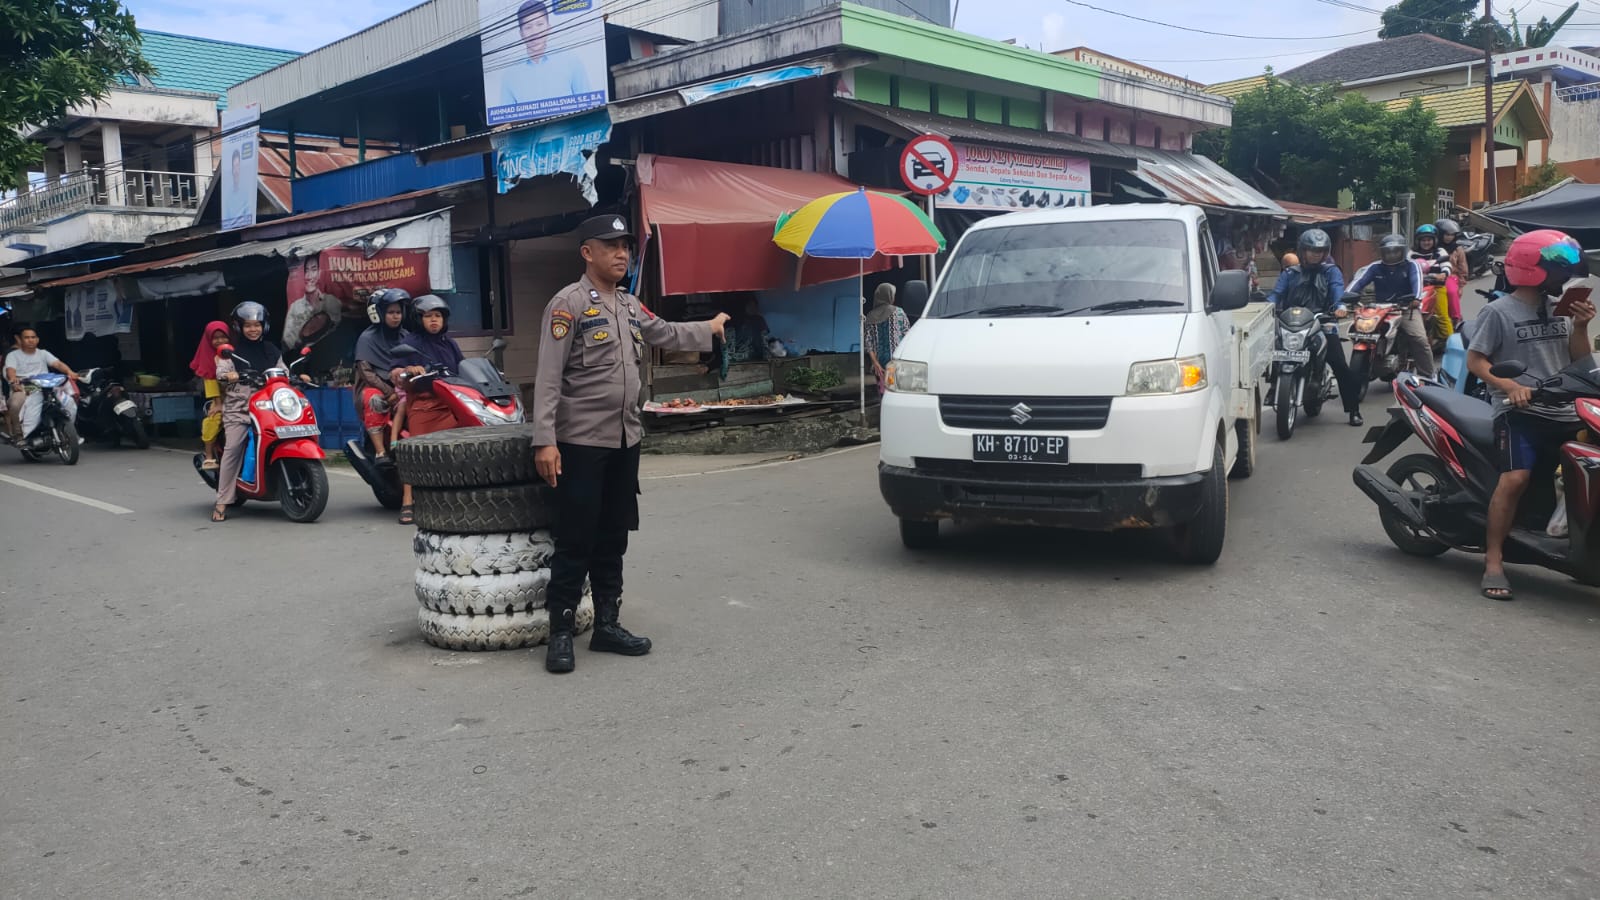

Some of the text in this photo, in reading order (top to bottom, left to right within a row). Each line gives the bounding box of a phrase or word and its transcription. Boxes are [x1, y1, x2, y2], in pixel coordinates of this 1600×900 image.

[490, 106, 515, 116] AKHMAD
[362, 256, 404, 271] PEDASNYA
[379, 266, 416, 281] SUASANA
[1516, 322, 1568, 339] GUESS
[977, 435, 1064, 454] KH 8710 EP
